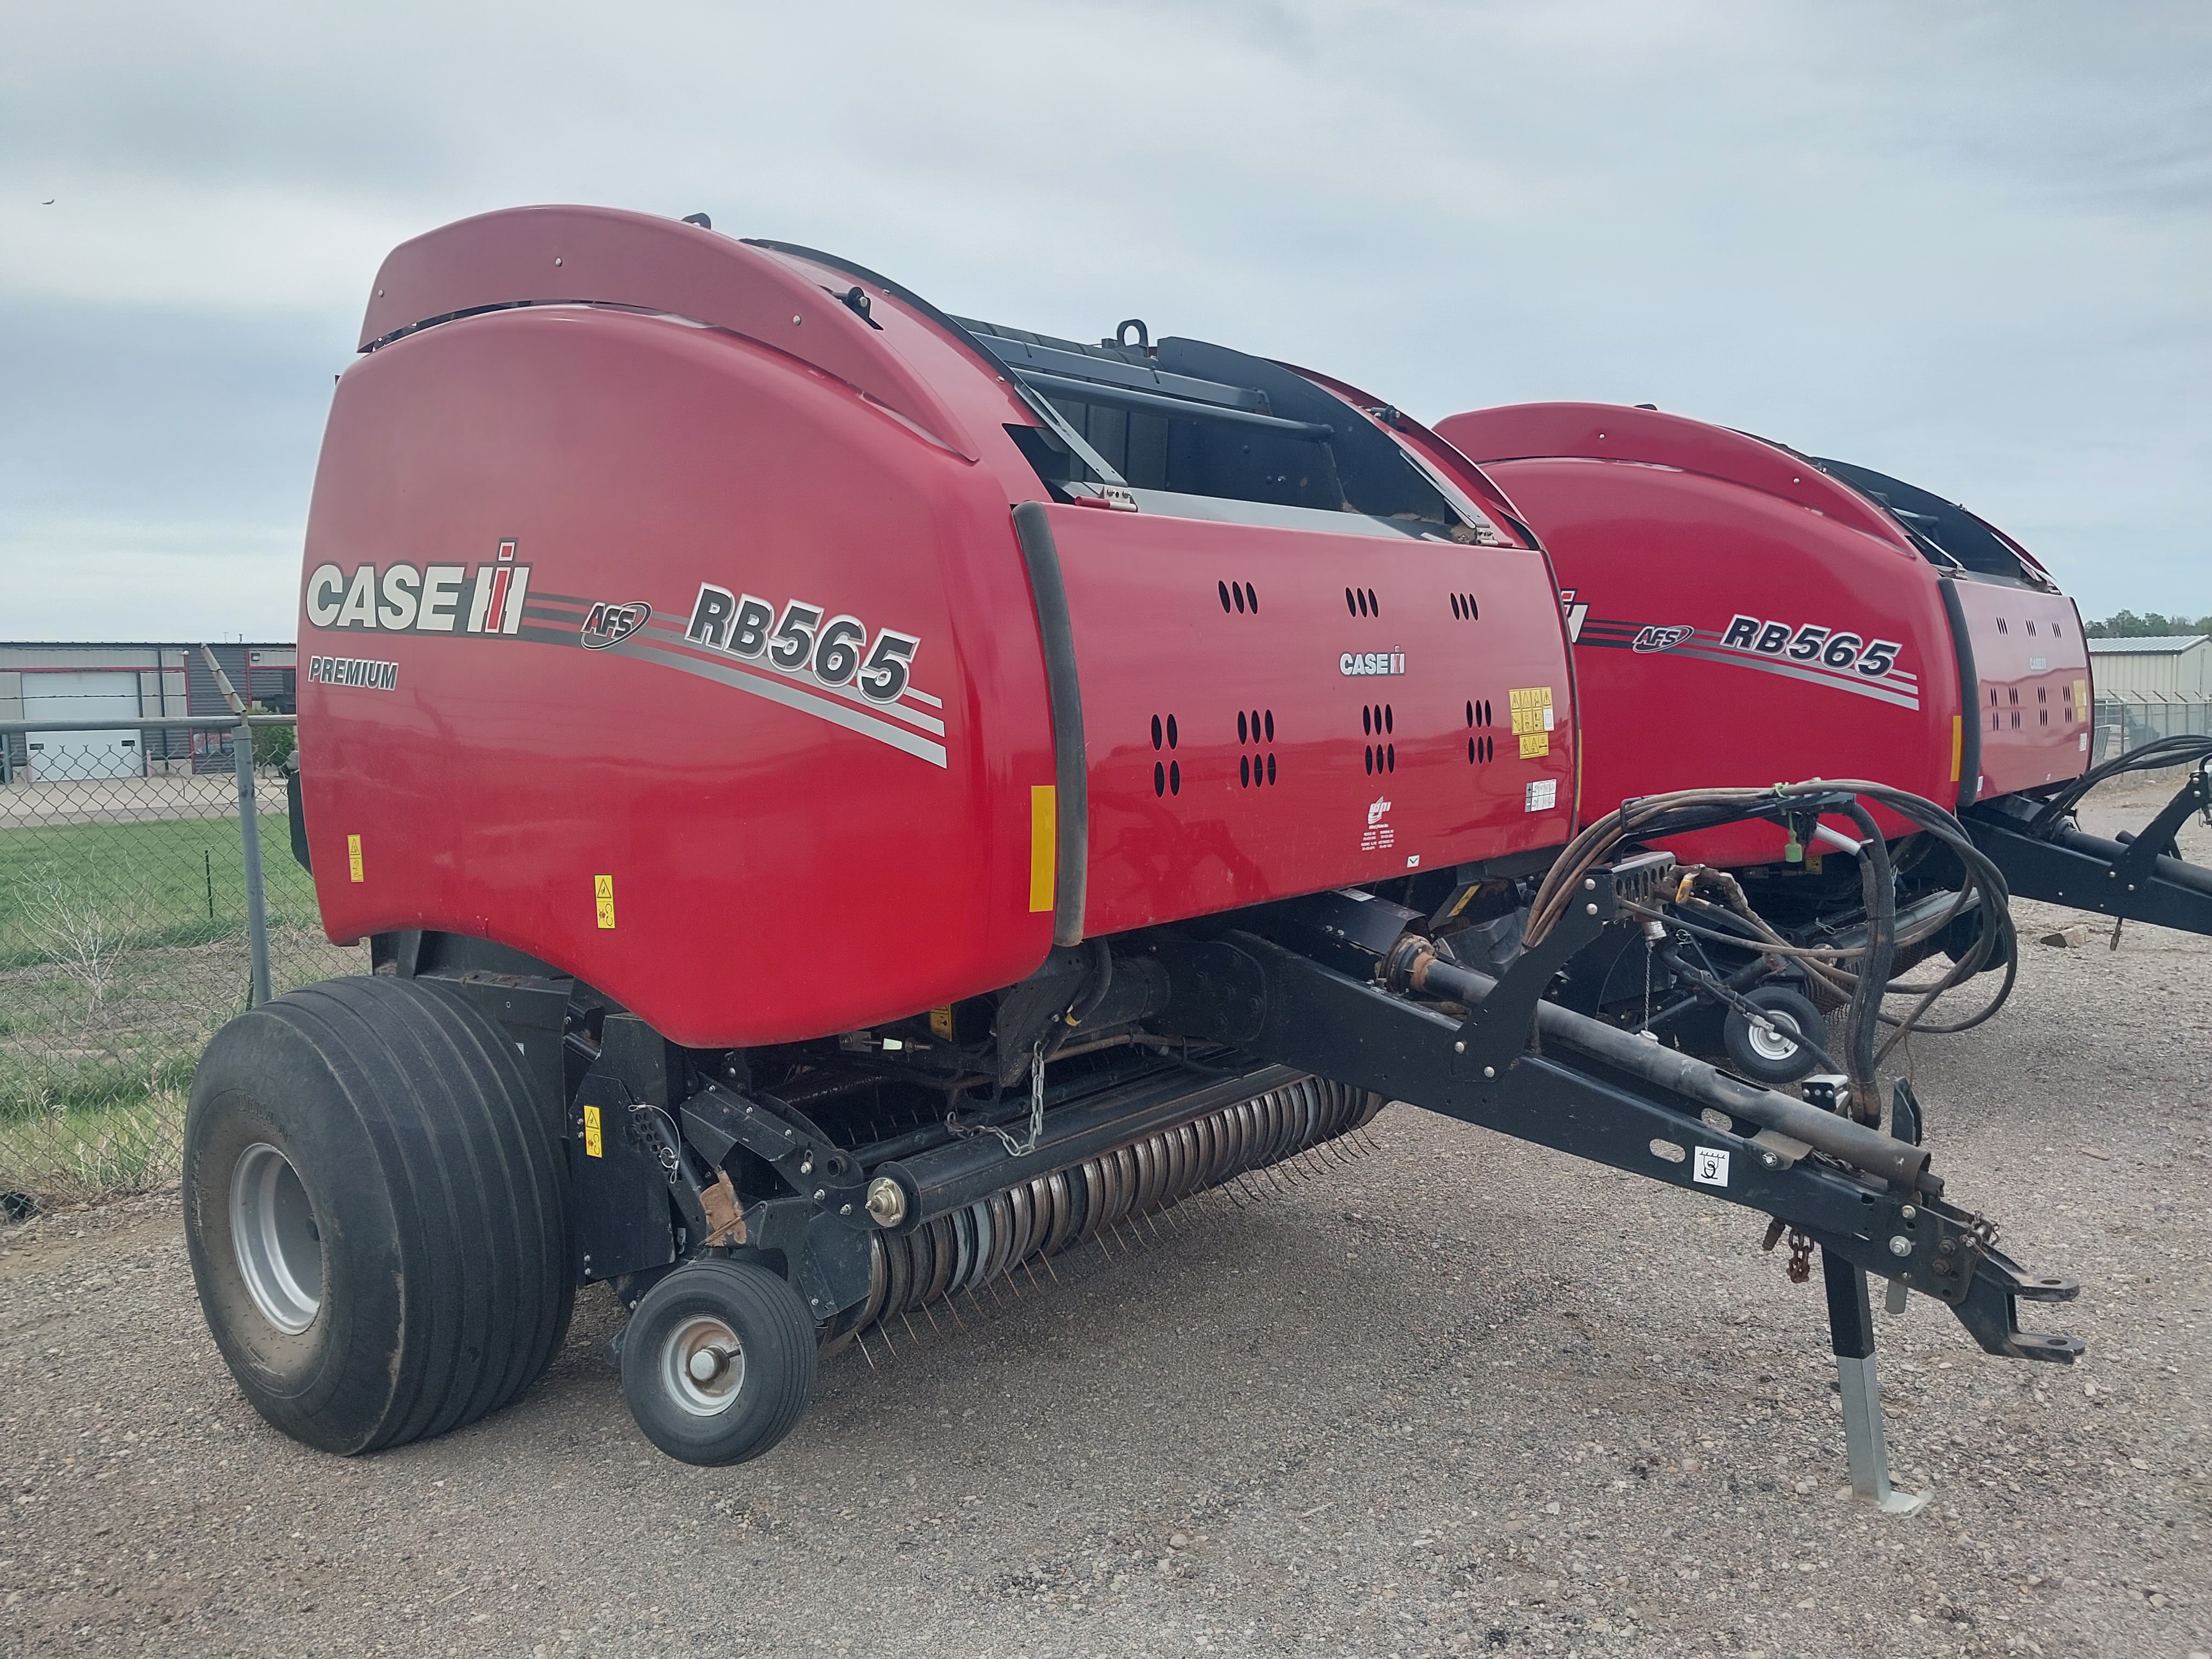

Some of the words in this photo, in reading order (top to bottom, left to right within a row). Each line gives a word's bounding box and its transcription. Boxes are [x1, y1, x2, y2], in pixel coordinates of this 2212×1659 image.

[306, 564, 465, 632] CASE
[581, 602, 638, 640] AFS
[1632, 626, 1682, 647] AFS
[684, 581, 921, 704] RB565
[1720, 614, 1902, 678] RB565
[307, 655, 399, 691] PREMIUM
[1340, 653, 1388, 676] CASE
